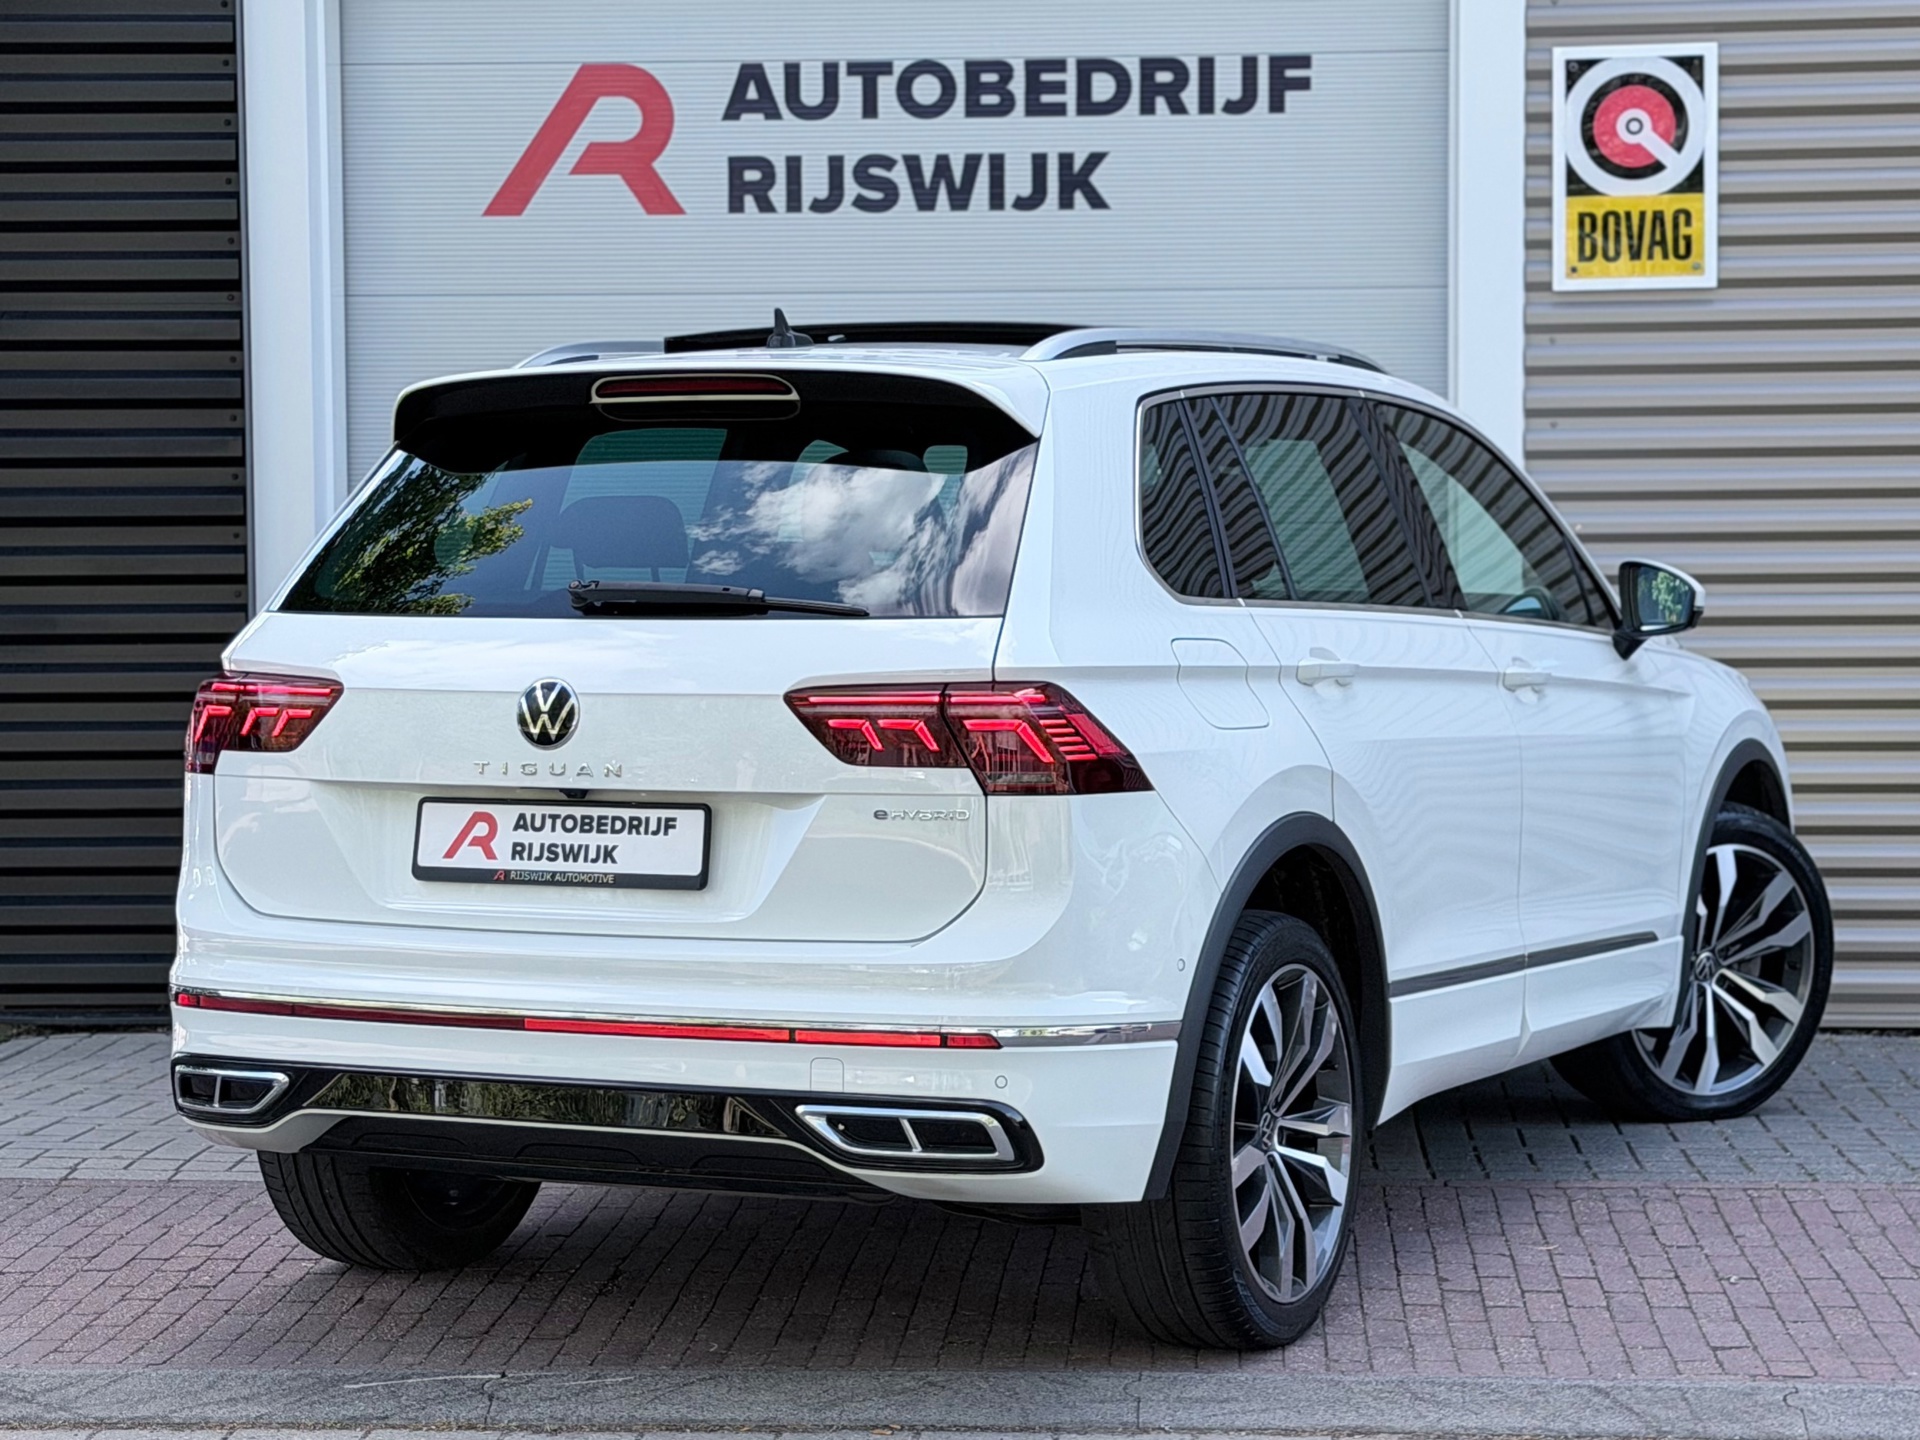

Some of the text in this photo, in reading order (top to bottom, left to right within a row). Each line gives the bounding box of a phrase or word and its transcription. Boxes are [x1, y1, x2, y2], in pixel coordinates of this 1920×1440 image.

[721, 55, 1312, 121] AUTOBEDRIJF
[727, 152, 1111, 214] RIJSWIJK
[1577, 208, 1693, 263] BOVAG
[473, 760, 623, 777] TIGUAN
[512, 812, 678, 837] AUTOBEDRIJF
[873, 808, 970, 820] eHYBRID
[510, 842, 619, 865] RIJSWIJK
[509, 871, 553, 881] RIJSWIJK
[554, 873, 615, 883] AUTOMOTIVE
